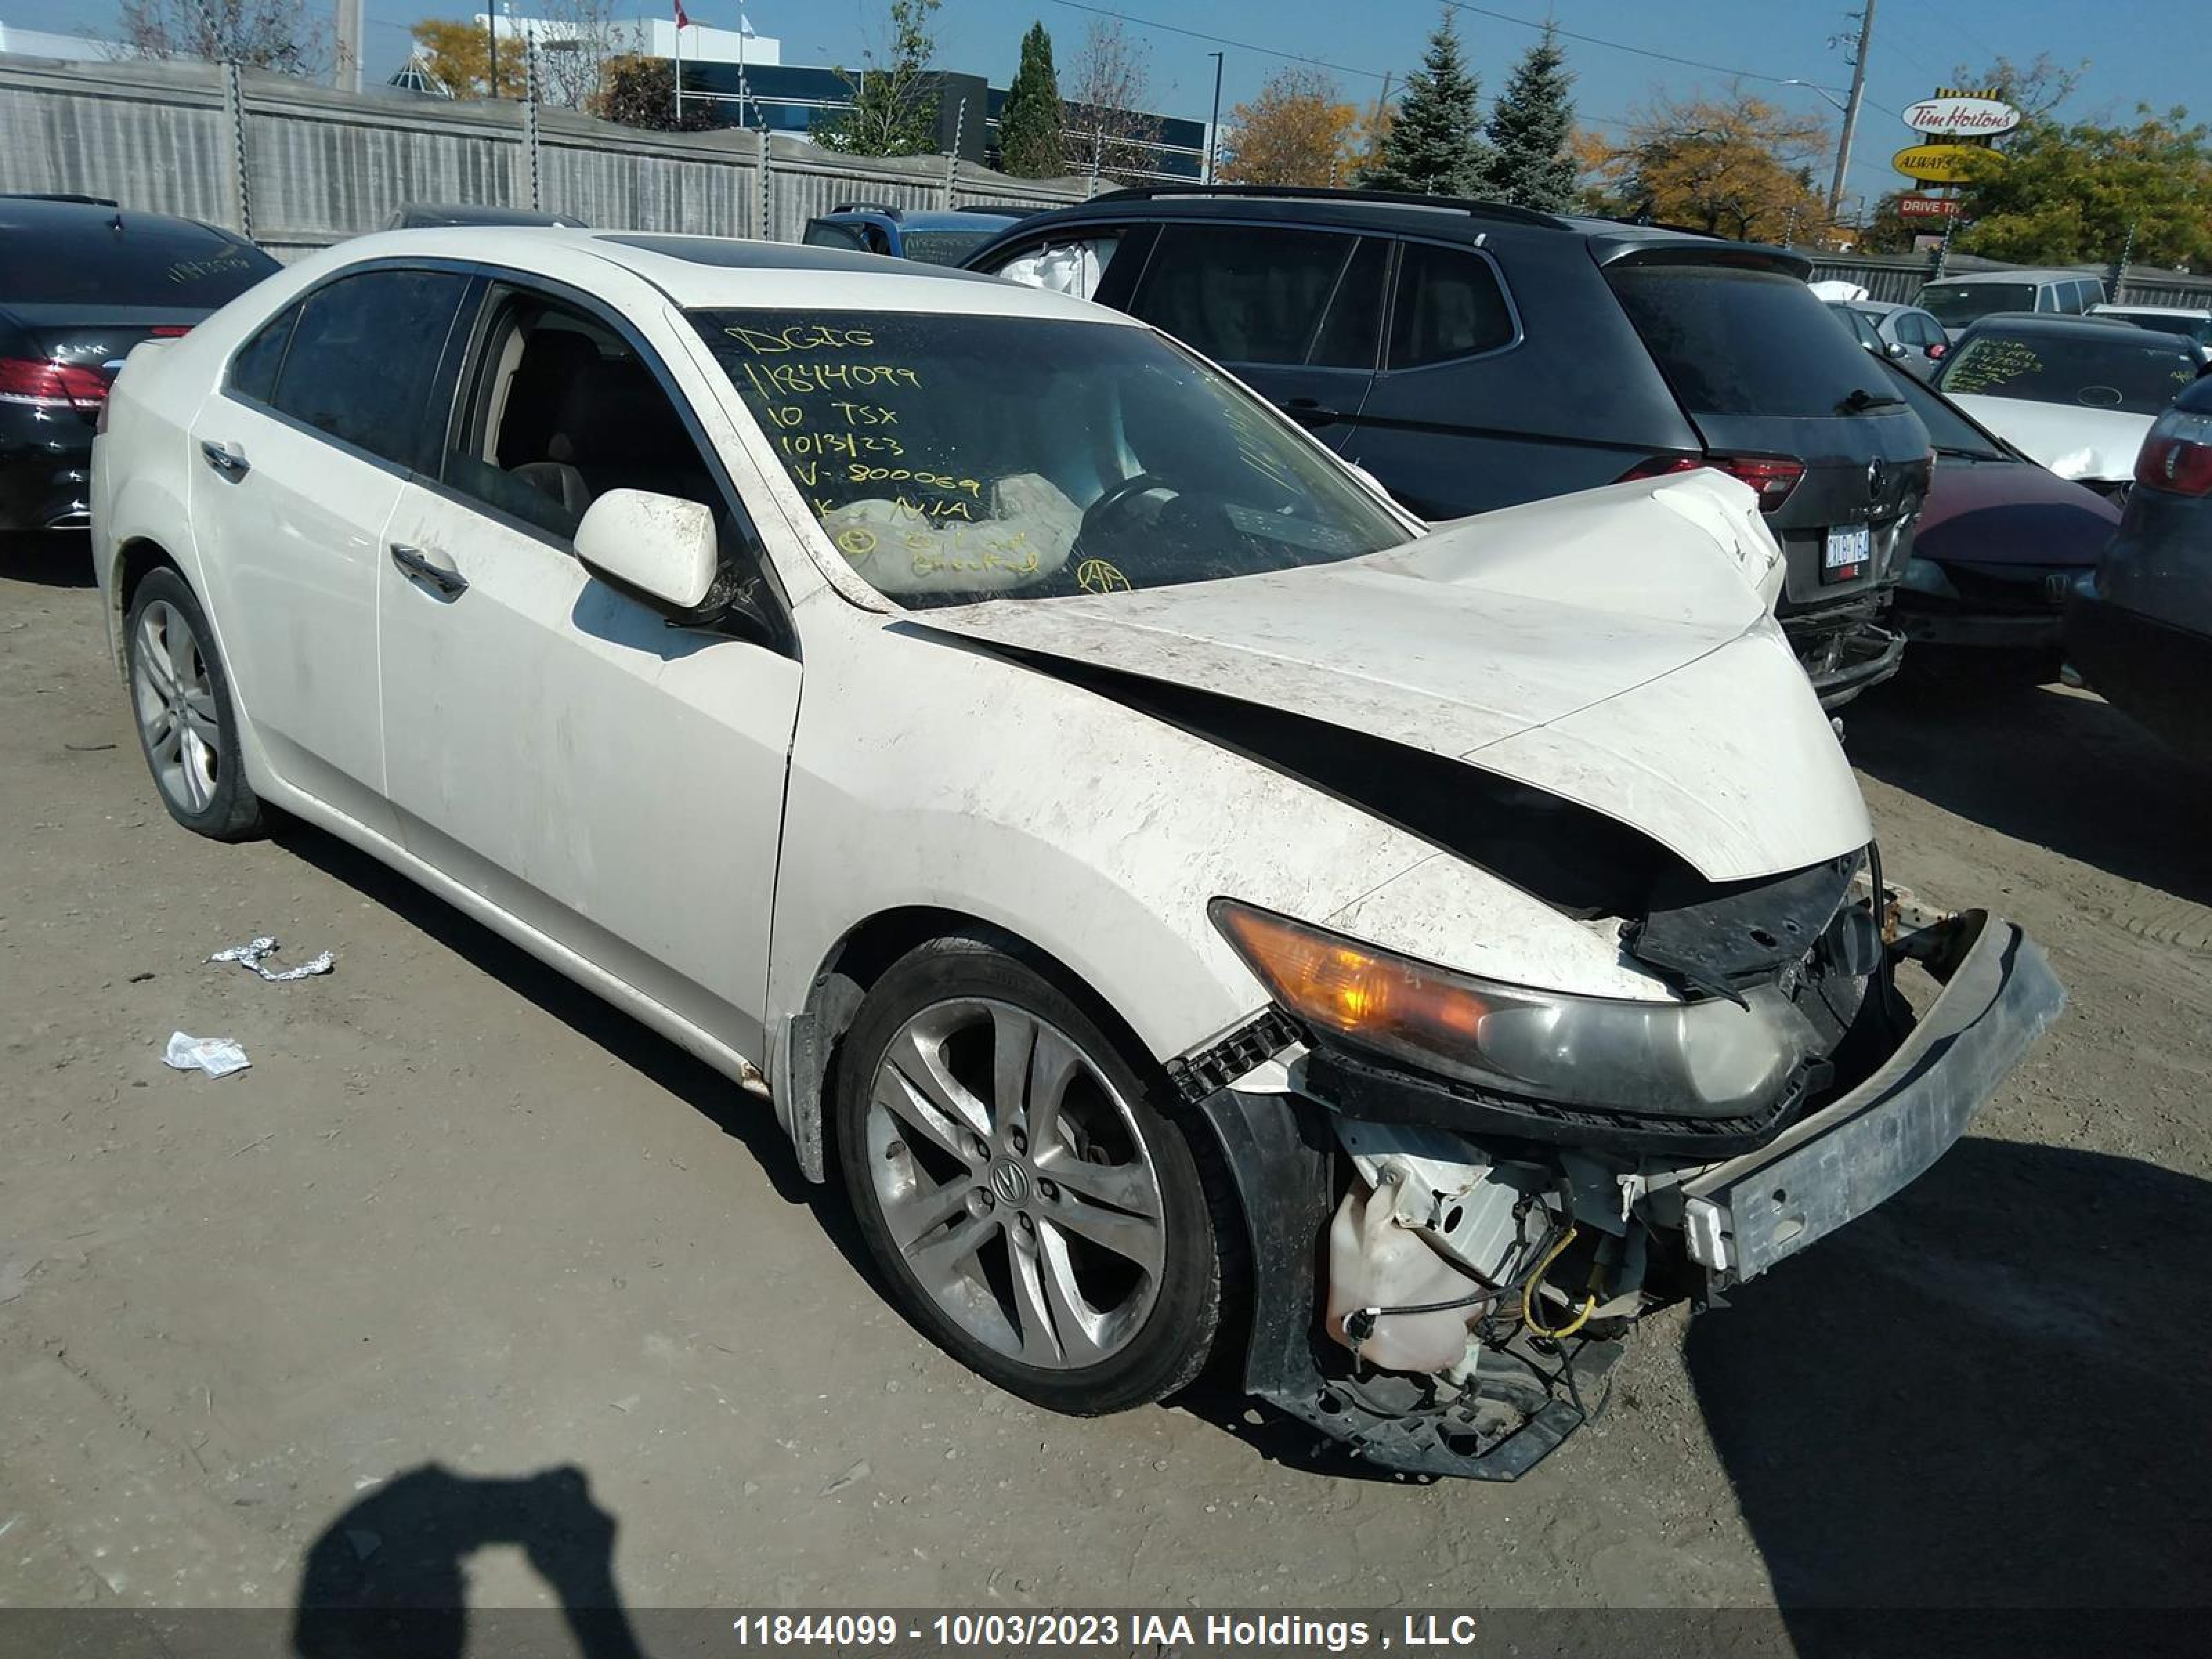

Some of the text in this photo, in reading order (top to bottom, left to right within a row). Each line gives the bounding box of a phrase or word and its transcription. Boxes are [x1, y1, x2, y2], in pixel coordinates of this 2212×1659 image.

[1912, 105, 1944, 126] Tim
[1903, 200, 1940, 212] DRIVE
[744, 363, 922, 400] 11844099
[767, 403, 898, 429] 10 TSX
[782, 432, 905, 457] 10/3/23
